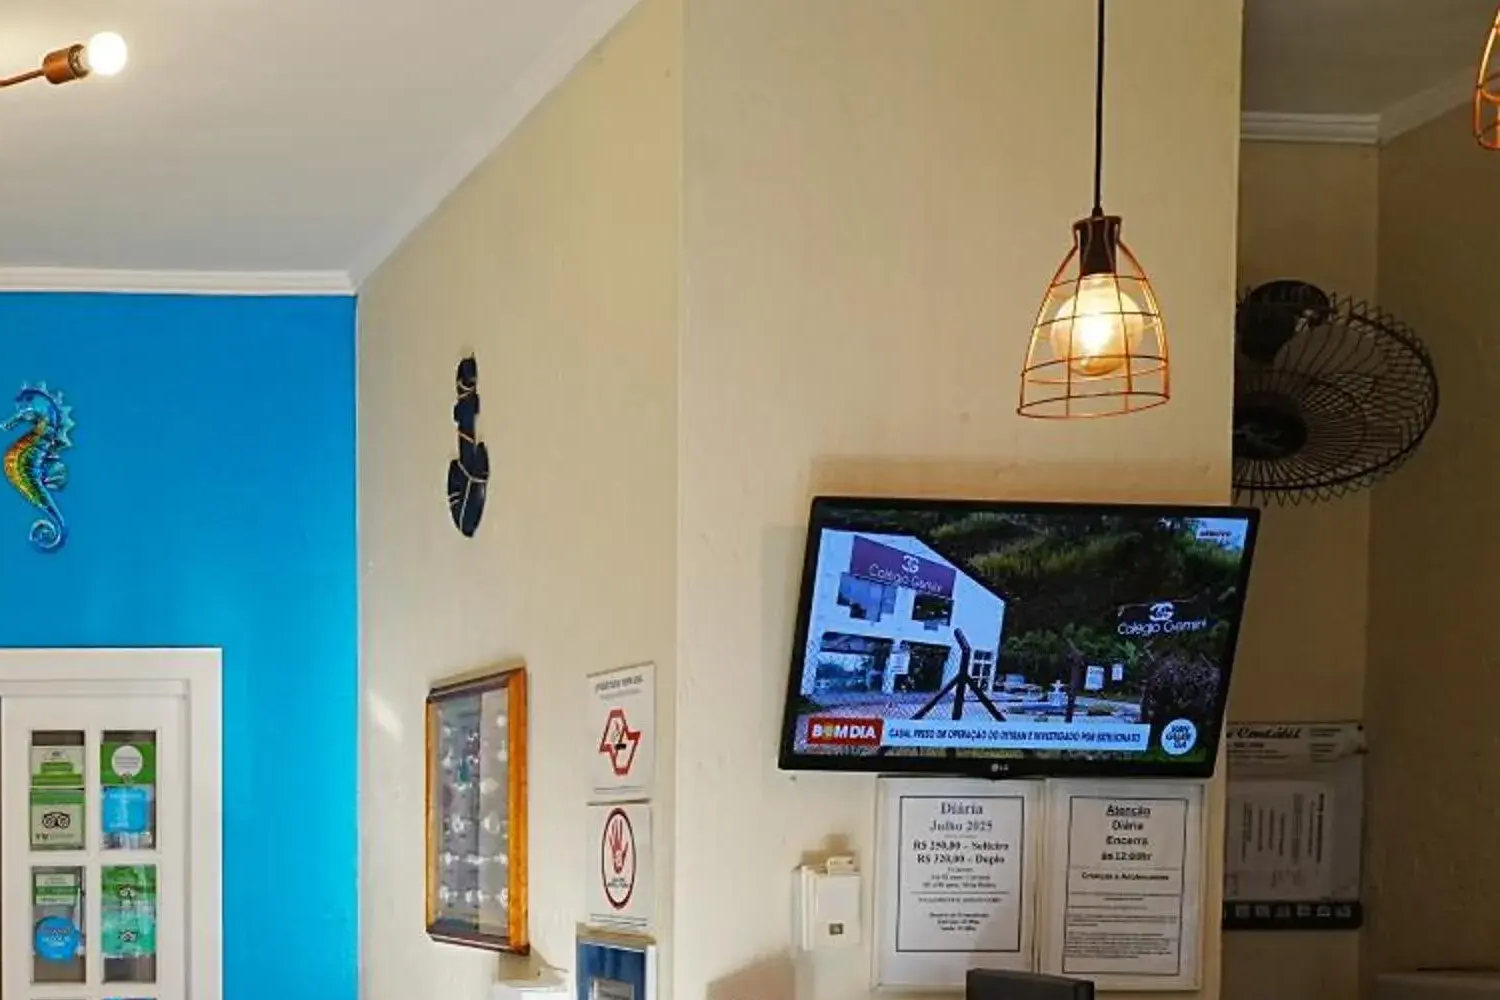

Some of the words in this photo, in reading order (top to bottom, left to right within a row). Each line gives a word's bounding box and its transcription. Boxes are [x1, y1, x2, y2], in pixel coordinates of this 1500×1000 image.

[811, 724, 849, 737] BOM
[850, 725, 877, 738] DIA
[940, 800, 984, 815] Diária
[929, 819, 963, 832] Julho
